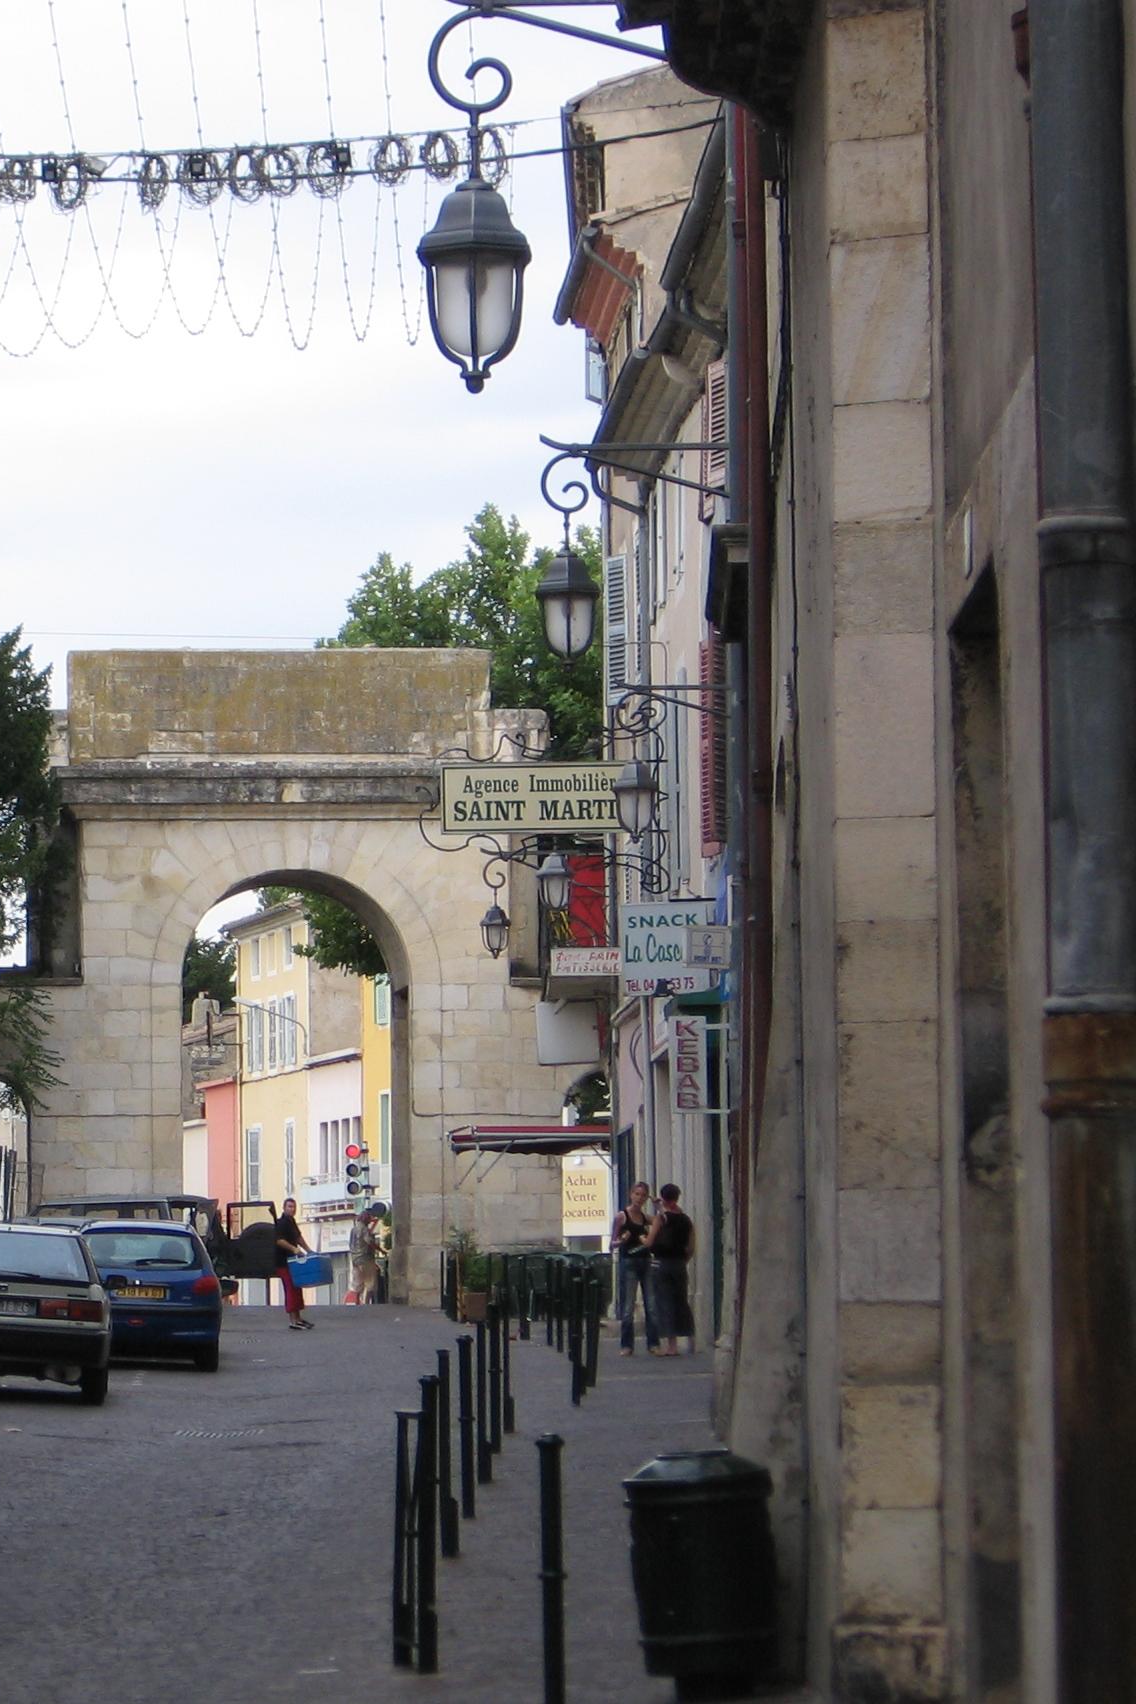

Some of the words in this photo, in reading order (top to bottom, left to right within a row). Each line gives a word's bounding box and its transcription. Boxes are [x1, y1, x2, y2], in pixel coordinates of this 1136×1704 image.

[463, 775, 519, 798] Agence
[529, 772, 617, 793] Immobilièr
[454, 800, 526, 822] SAINT
[539, 799, 617, 821] MARTI
[628, 913, 698, 929] SNACK
[625, 934, 642, 963] La
[676, 1020, 700, 1109] KEBAB
[565, 1175, 597, 1186] Achat
[566, 1190, 597, 1201] Vente
